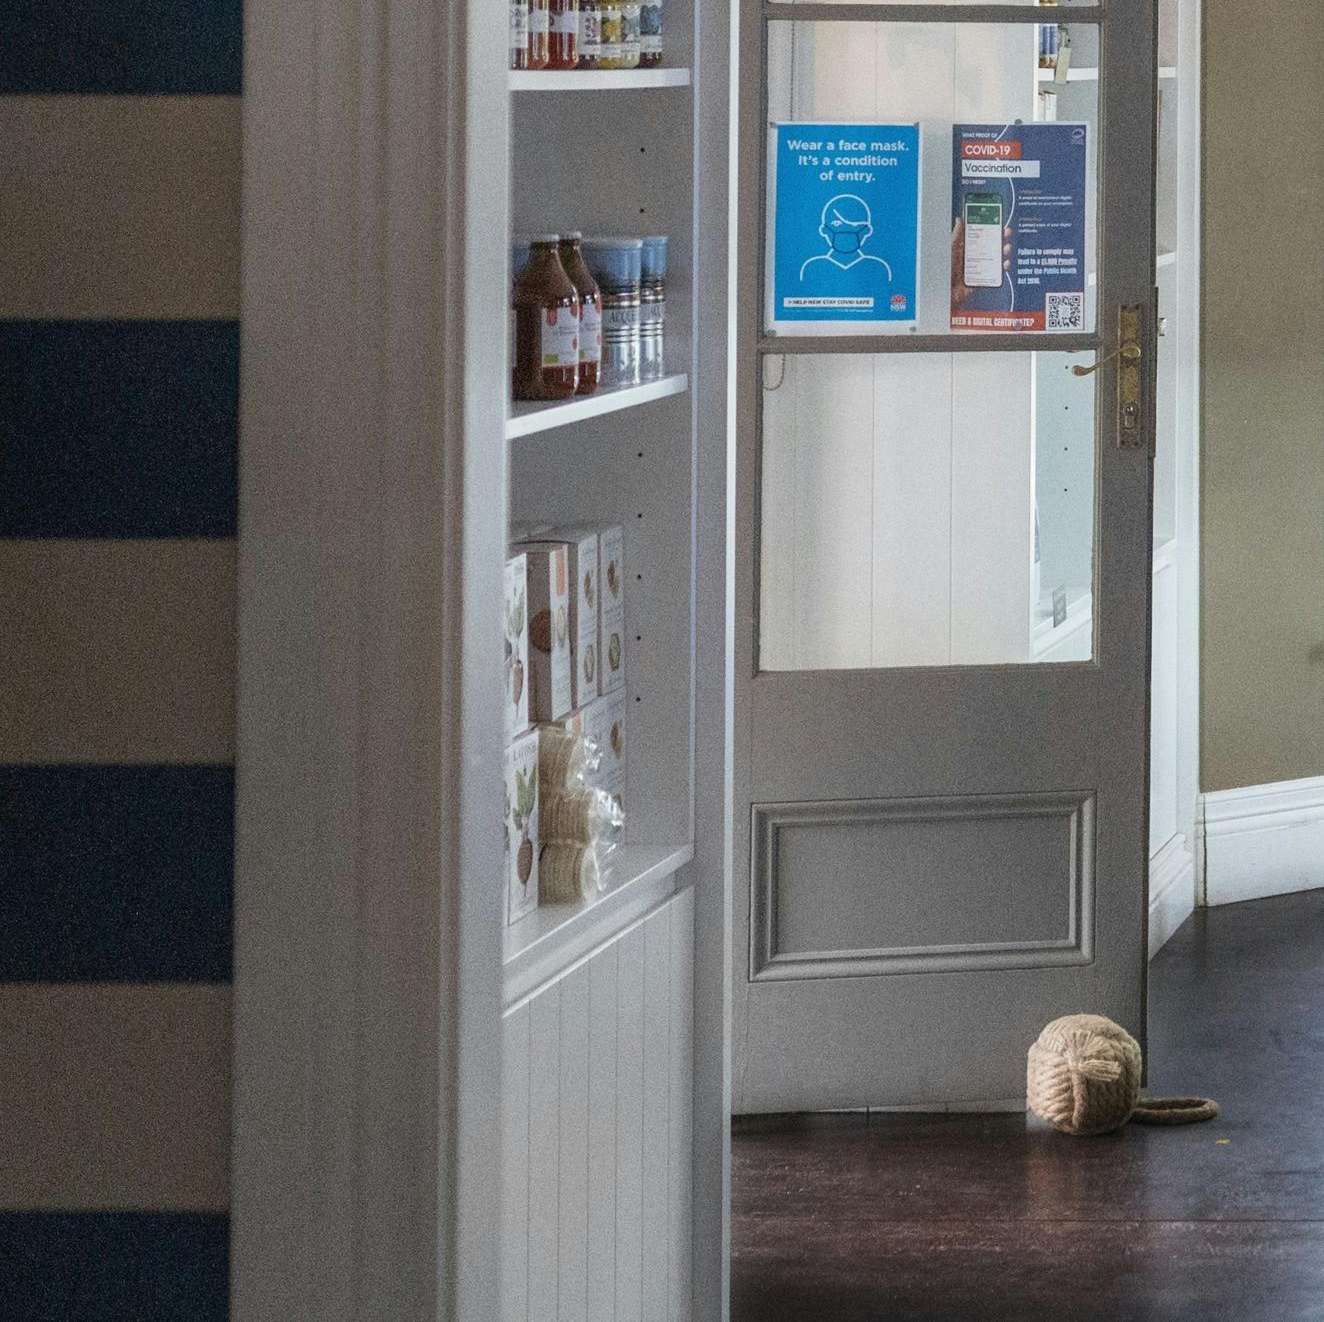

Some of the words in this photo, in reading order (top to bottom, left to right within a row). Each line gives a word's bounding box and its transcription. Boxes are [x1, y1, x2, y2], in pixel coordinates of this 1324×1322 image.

[787, 140, 822, 151] Wear
[826, 142, 835, 151] a
[839, 139, 867, 151] face
[870, 140, 909, 151] mask.
[965, 145, 1011, 156] COVID-19
[798, 155, 818, 166] It's
[822, 157, 831, 166] a
[834, 155, 898, 166] condition
[965, 163, 1022, 173] Vaccination
[820, 170, 833, 181] of
[837, 171, 876, 183] entry.
